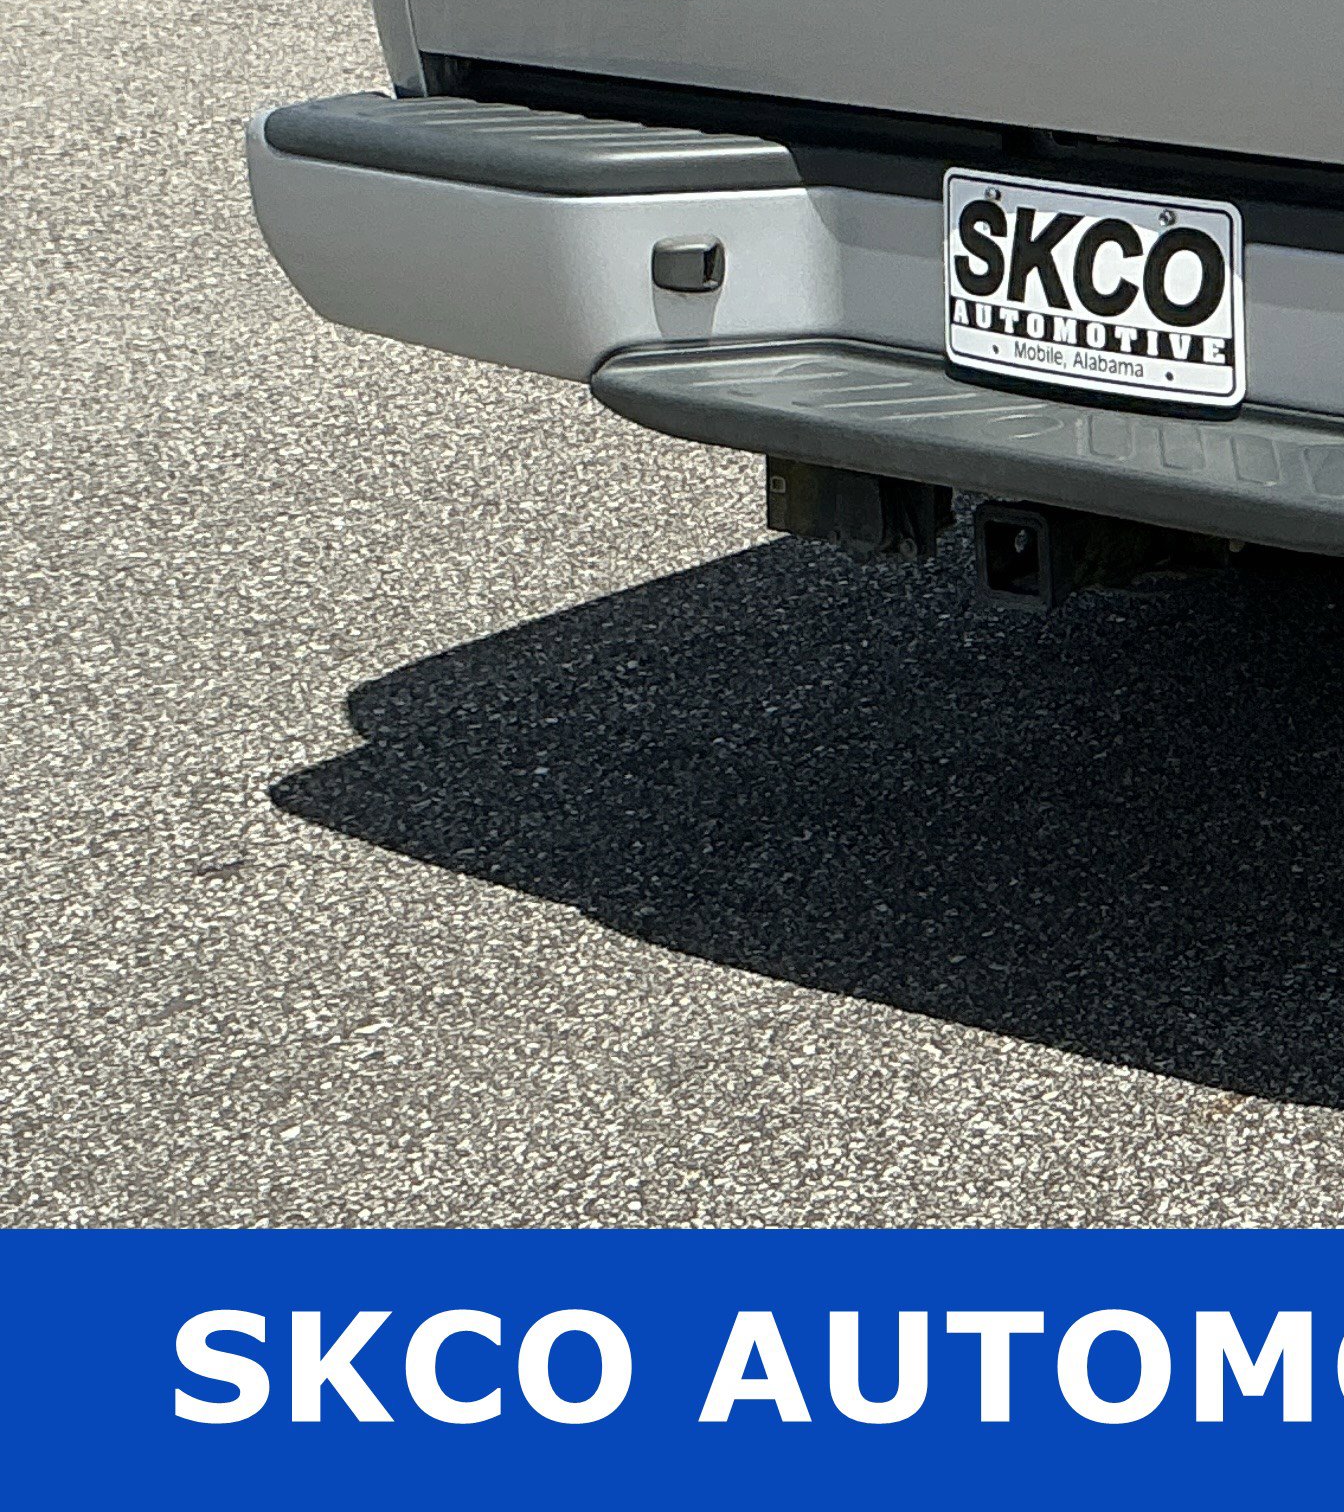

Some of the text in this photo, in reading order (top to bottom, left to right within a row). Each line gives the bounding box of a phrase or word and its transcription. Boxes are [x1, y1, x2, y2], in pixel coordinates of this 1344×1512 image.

[953, 199, 1226, 328] SKCO
[952, 299, 1226, 365] AUTOMOTIVE
[1014, 341, 1145, 378] Mobile, Alabama
